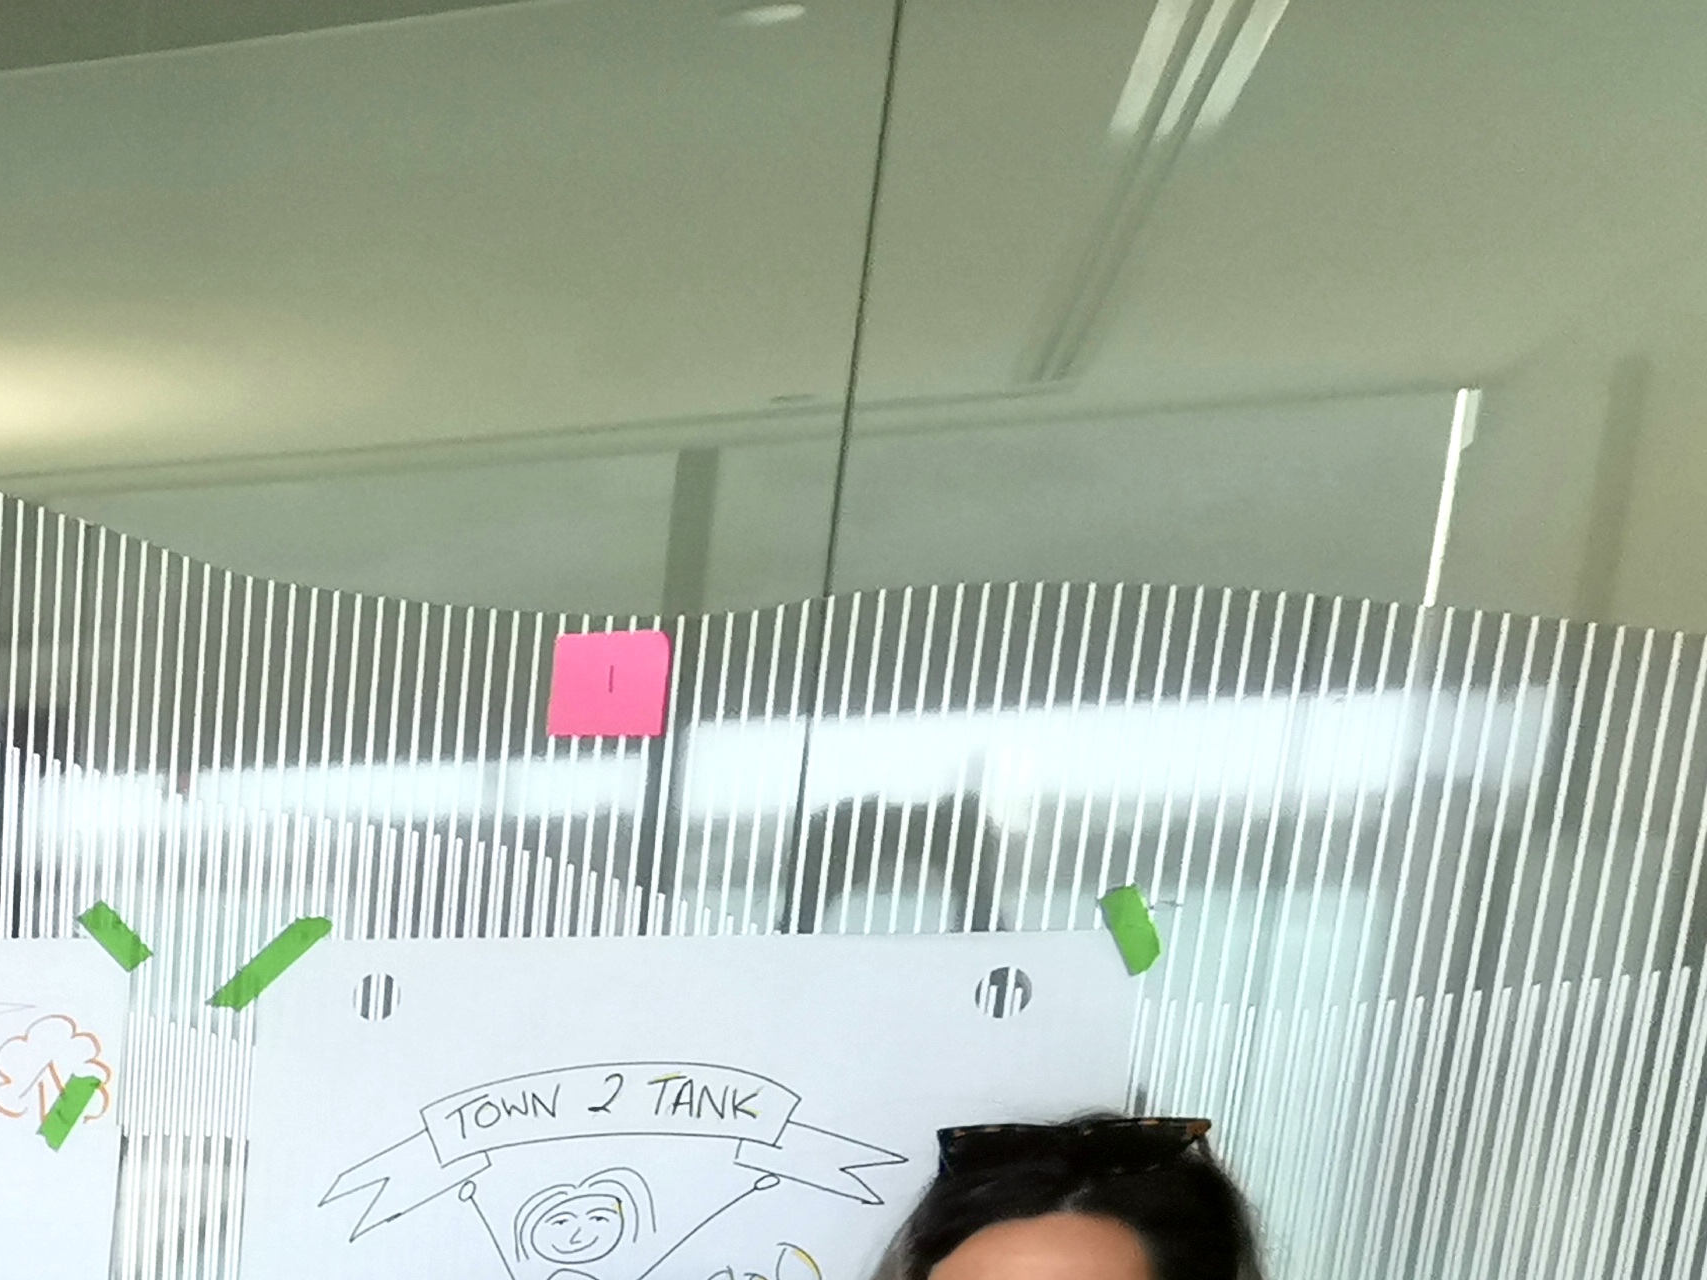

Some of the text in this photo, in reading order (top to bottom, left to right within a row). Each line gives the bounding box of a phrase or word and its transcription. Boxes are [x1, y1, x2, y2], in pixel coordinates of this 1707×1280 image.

[444, 1072, 763, 1139] TOWN 2 TANK
